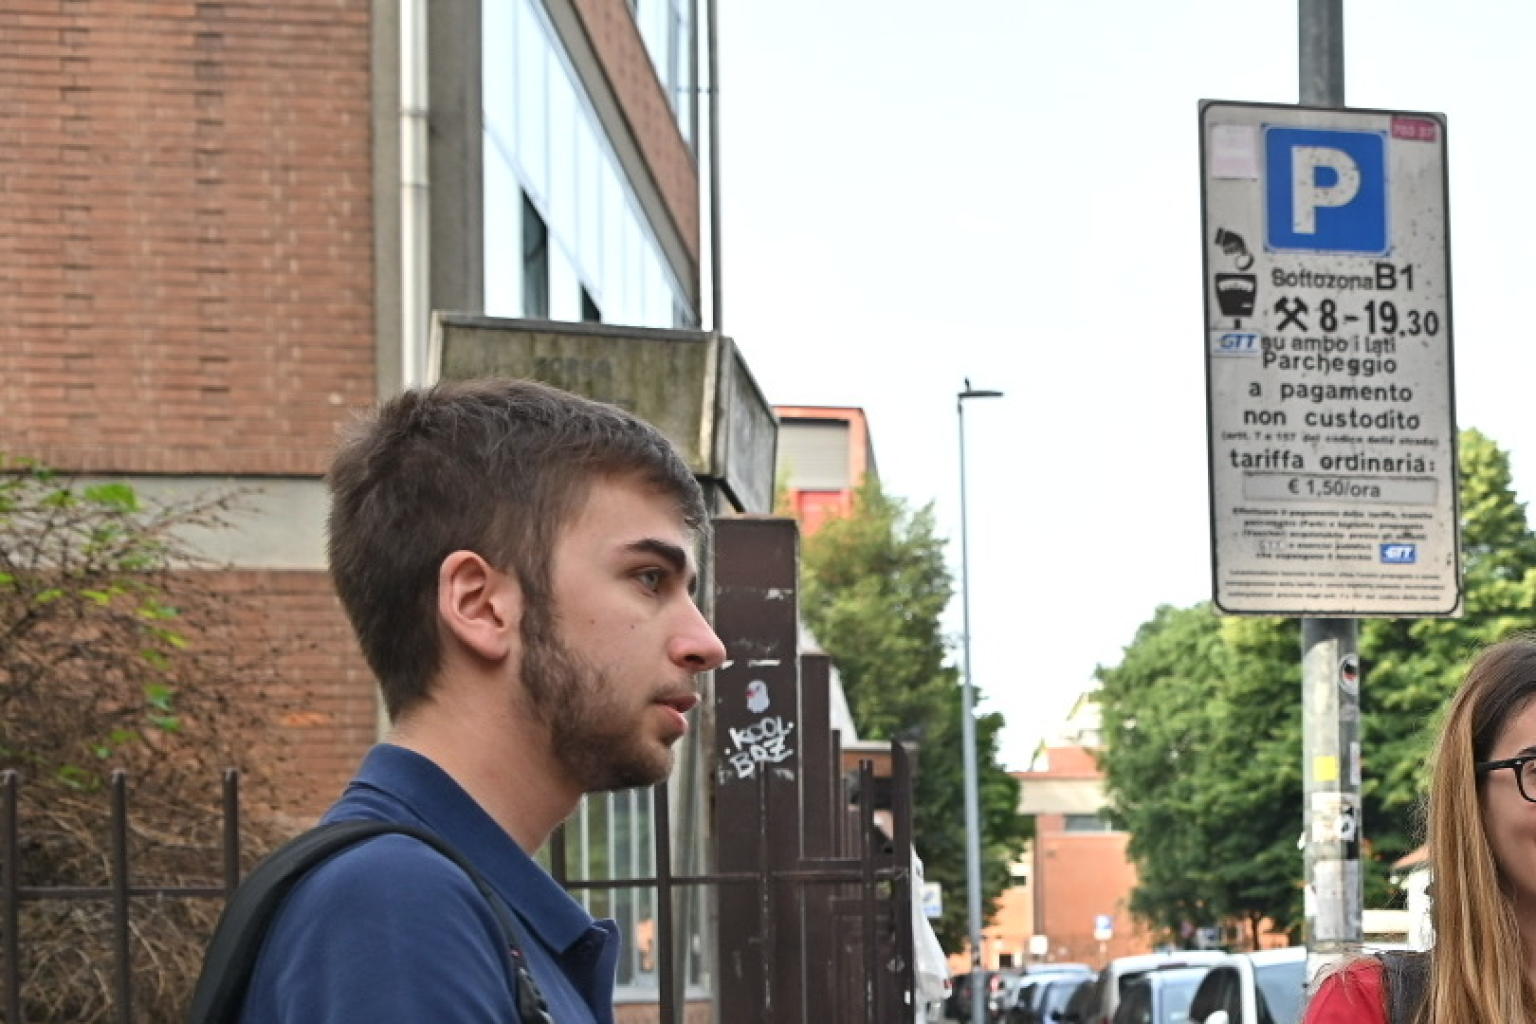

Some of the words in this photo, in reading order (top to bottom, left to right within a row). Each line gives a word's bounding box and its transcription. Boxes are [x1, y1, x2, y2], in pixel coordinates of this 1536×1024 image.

[1292, 145, 1361, 235] P
[1272, 267, 1373, 290] Sottozona
[1375, 262, 1414, 291] B1
[1261, 336, 1286, 350] su
[1292, 336, 1349, 352] ambo
[1353, 336, 1360, 351] i
[1365, 336, 1397, 353] lati
[1262, 350, 1397, 376] Parcheggio
[1248, 382, 1262, 397] a
[1280, 382, 1413, 403] pagamento
[1243, 409, 1287, 426] non
[1305, 407, 1421, 430] custodito
[1230, 449, 1304, 469] tariffa
[1319, 452, 1435, 473] ordinaria:
[1287, 478, 1300, 494] €
[1306, 478, 1382, 498] 1,50/ora
